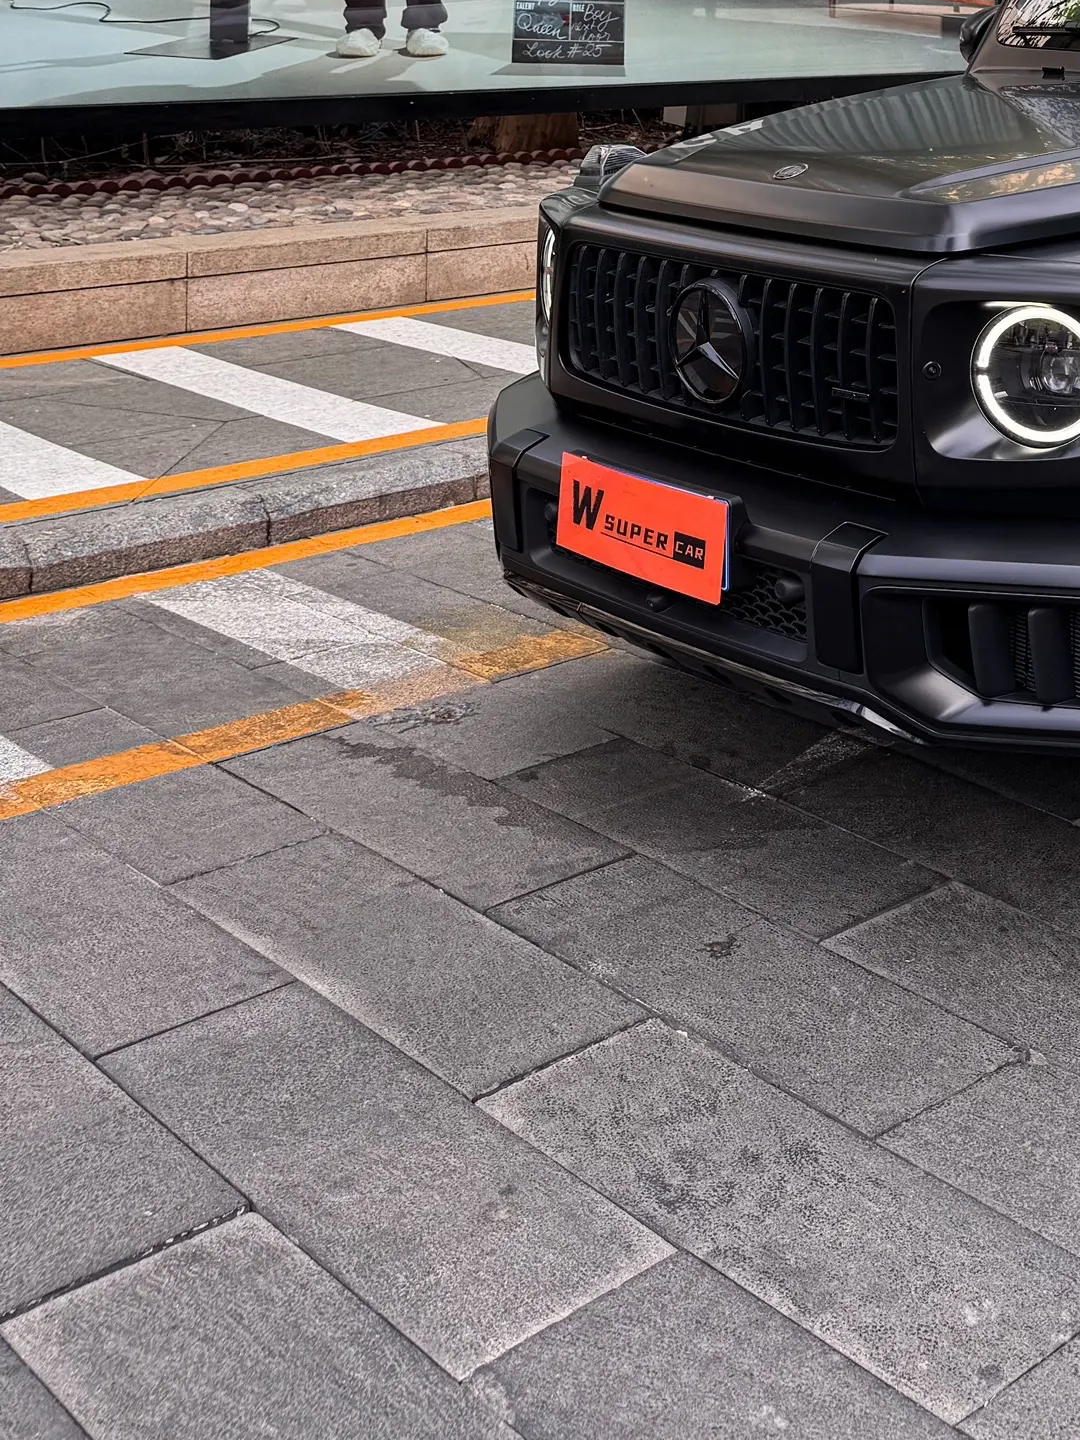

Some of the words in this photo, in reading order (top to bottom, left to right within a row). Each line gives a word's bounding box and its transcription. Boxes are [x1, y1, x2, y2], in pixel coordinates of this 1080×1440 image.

[516, 1, 536, 10] TALENT
[572, 4, 585, 12] ROLE
[517, 13, 568, 40] Queen
[583, 3, 620, 32] Boy
[522, 41, 566, 58] Look
[572, 478, 605, 531] W
[604, 514, 669, 551] SUPER
[675, 540, 704, 561] CAR
